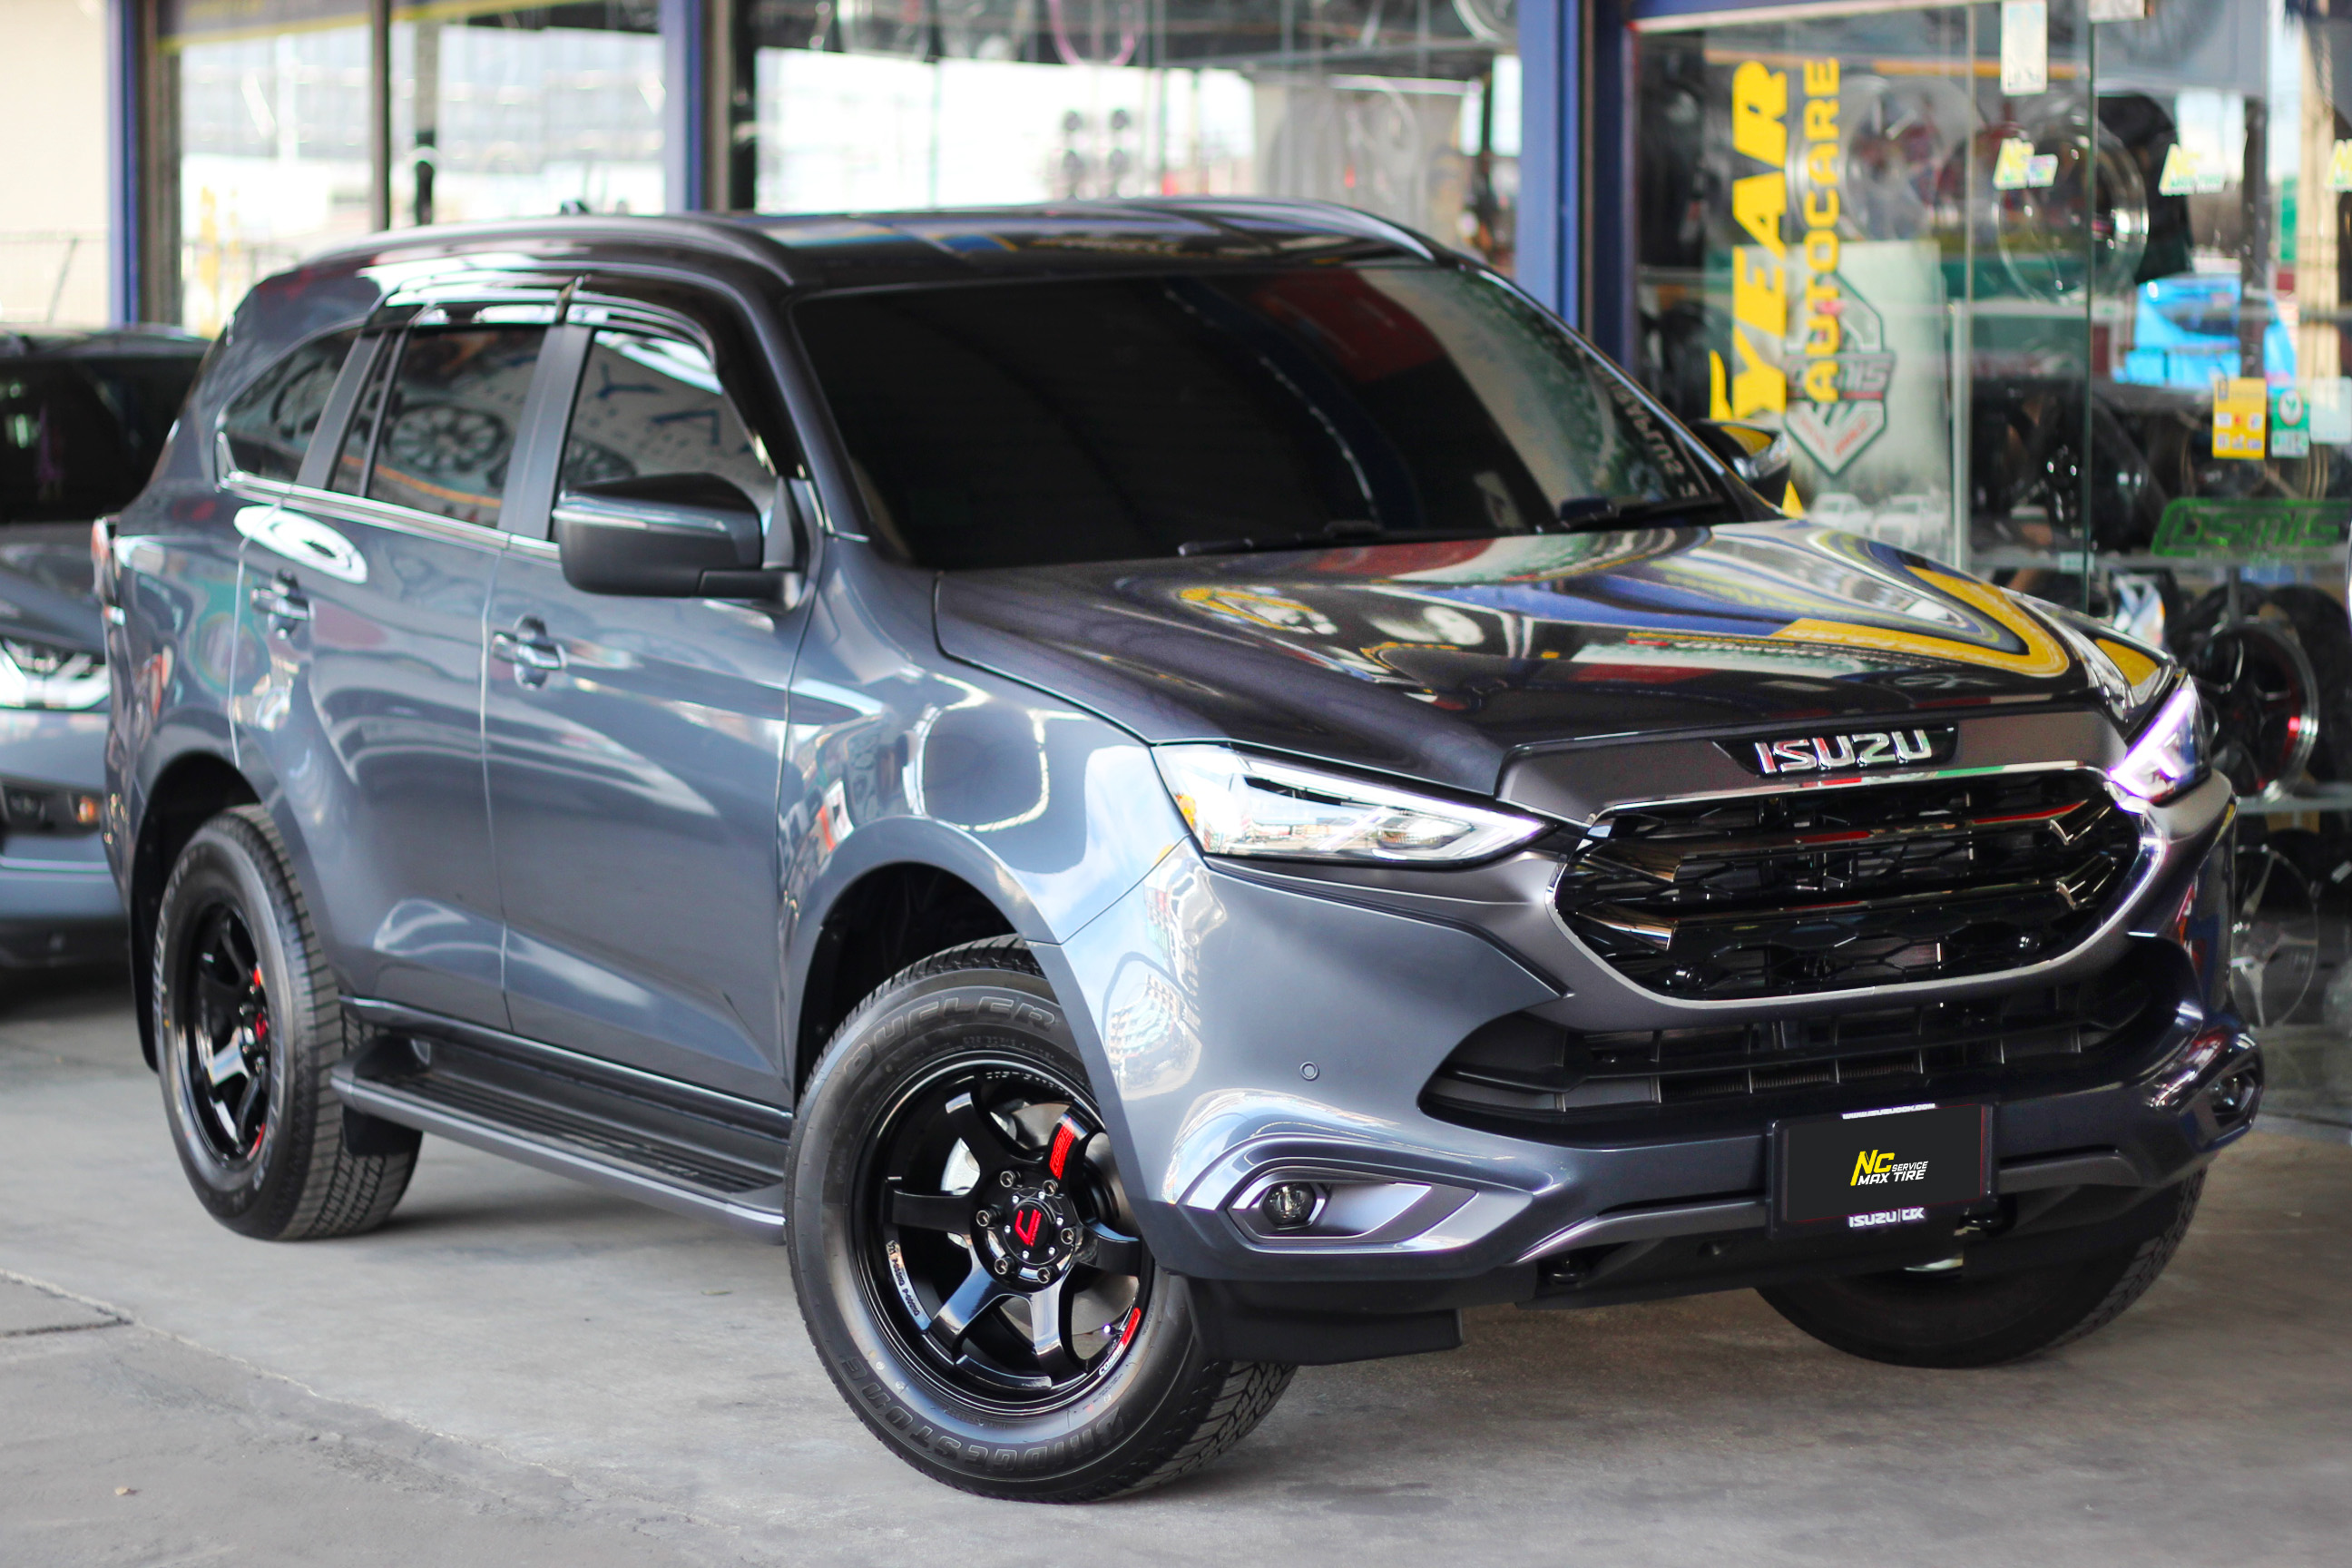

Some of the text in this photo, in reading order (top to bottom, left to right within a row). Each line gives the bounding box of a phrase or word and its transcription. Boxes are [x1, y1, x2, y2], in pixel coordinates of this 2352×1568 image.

[1804, 57, 1840, 403] AUTOCARE
[1754, 729, 1933, 774] ISUZU
[843, 995, 1055, 1078] DUELER
[1848, 1210, 1896, 1228] ISUZU
[1098, 1341, 1125, 1377] COSMIS
[840, 1355, 1125, 1472] BRIDGESTONE
